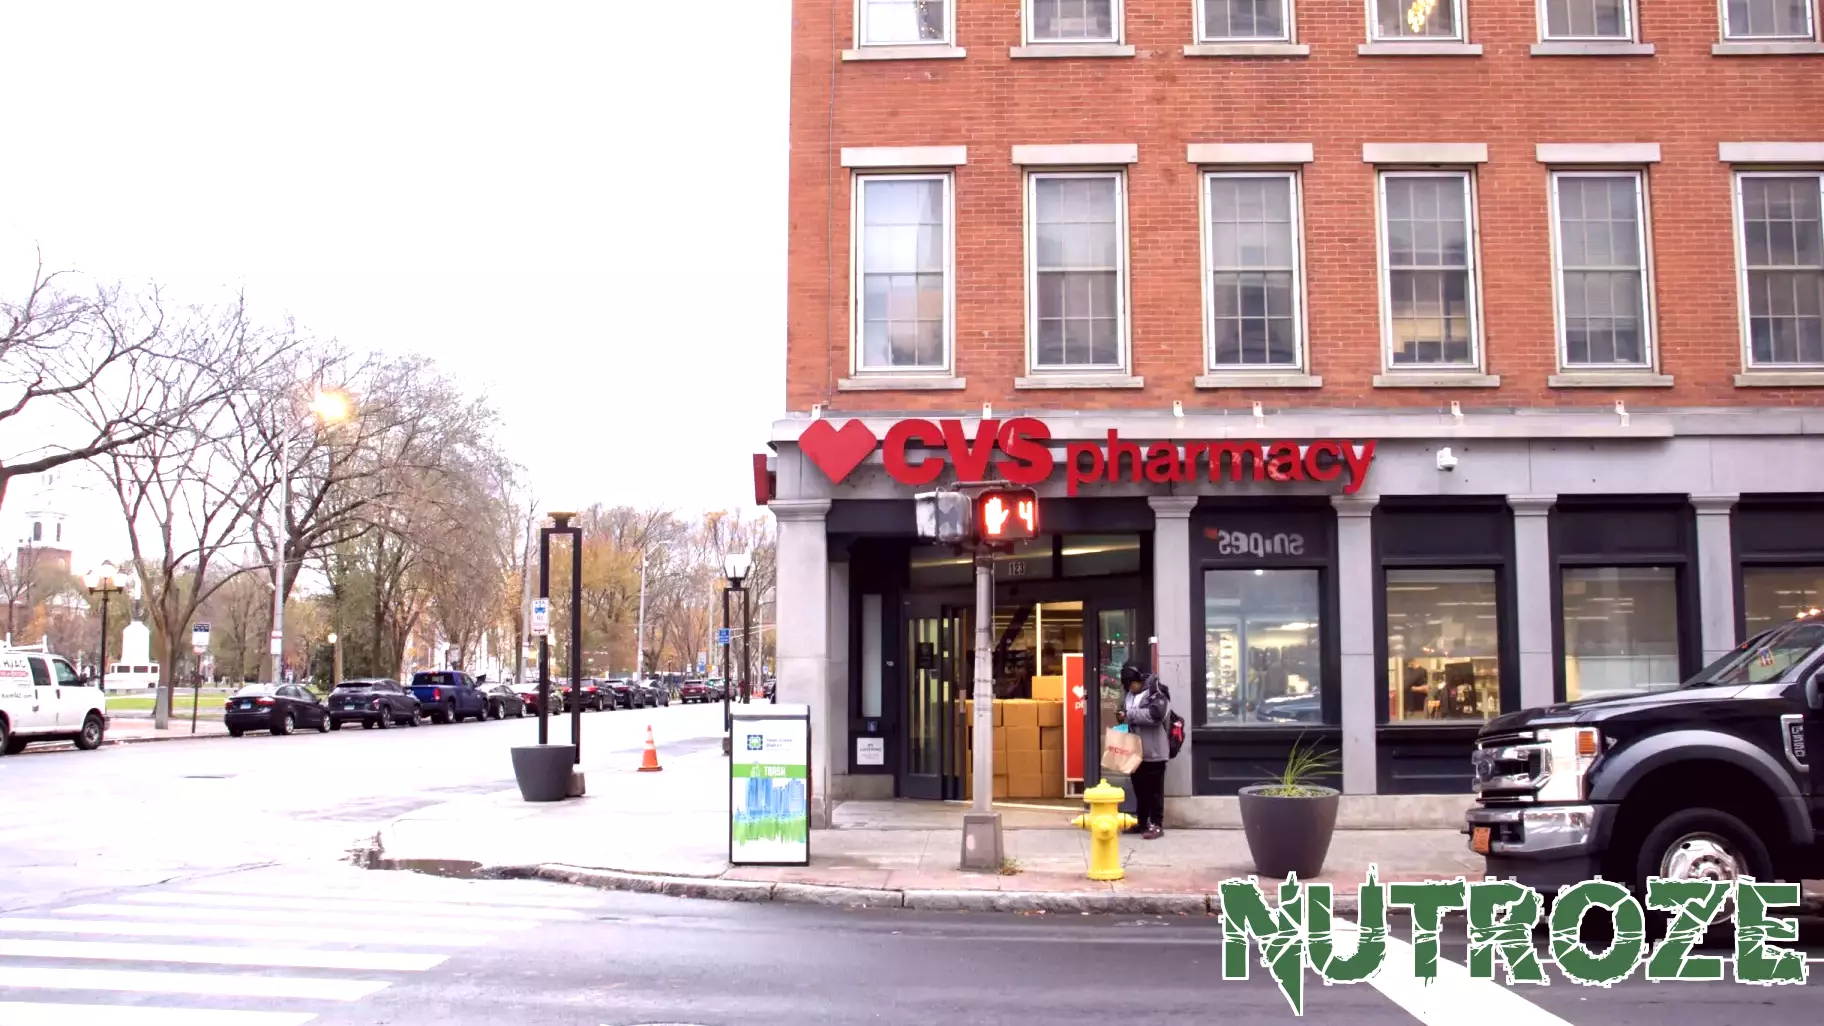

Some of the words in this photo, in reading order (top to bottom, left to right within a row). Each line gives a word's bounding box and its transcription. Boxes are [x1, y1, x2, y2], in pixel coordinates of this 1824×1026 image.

[883, 417, 1053, 485] CVS
[1066, 428, 1376, 496] pharmacy
[1019, 500, 1033, 532] 4
[1009, 562, 1025, 575] 123
[764, 766, 786, 777] TRASH
